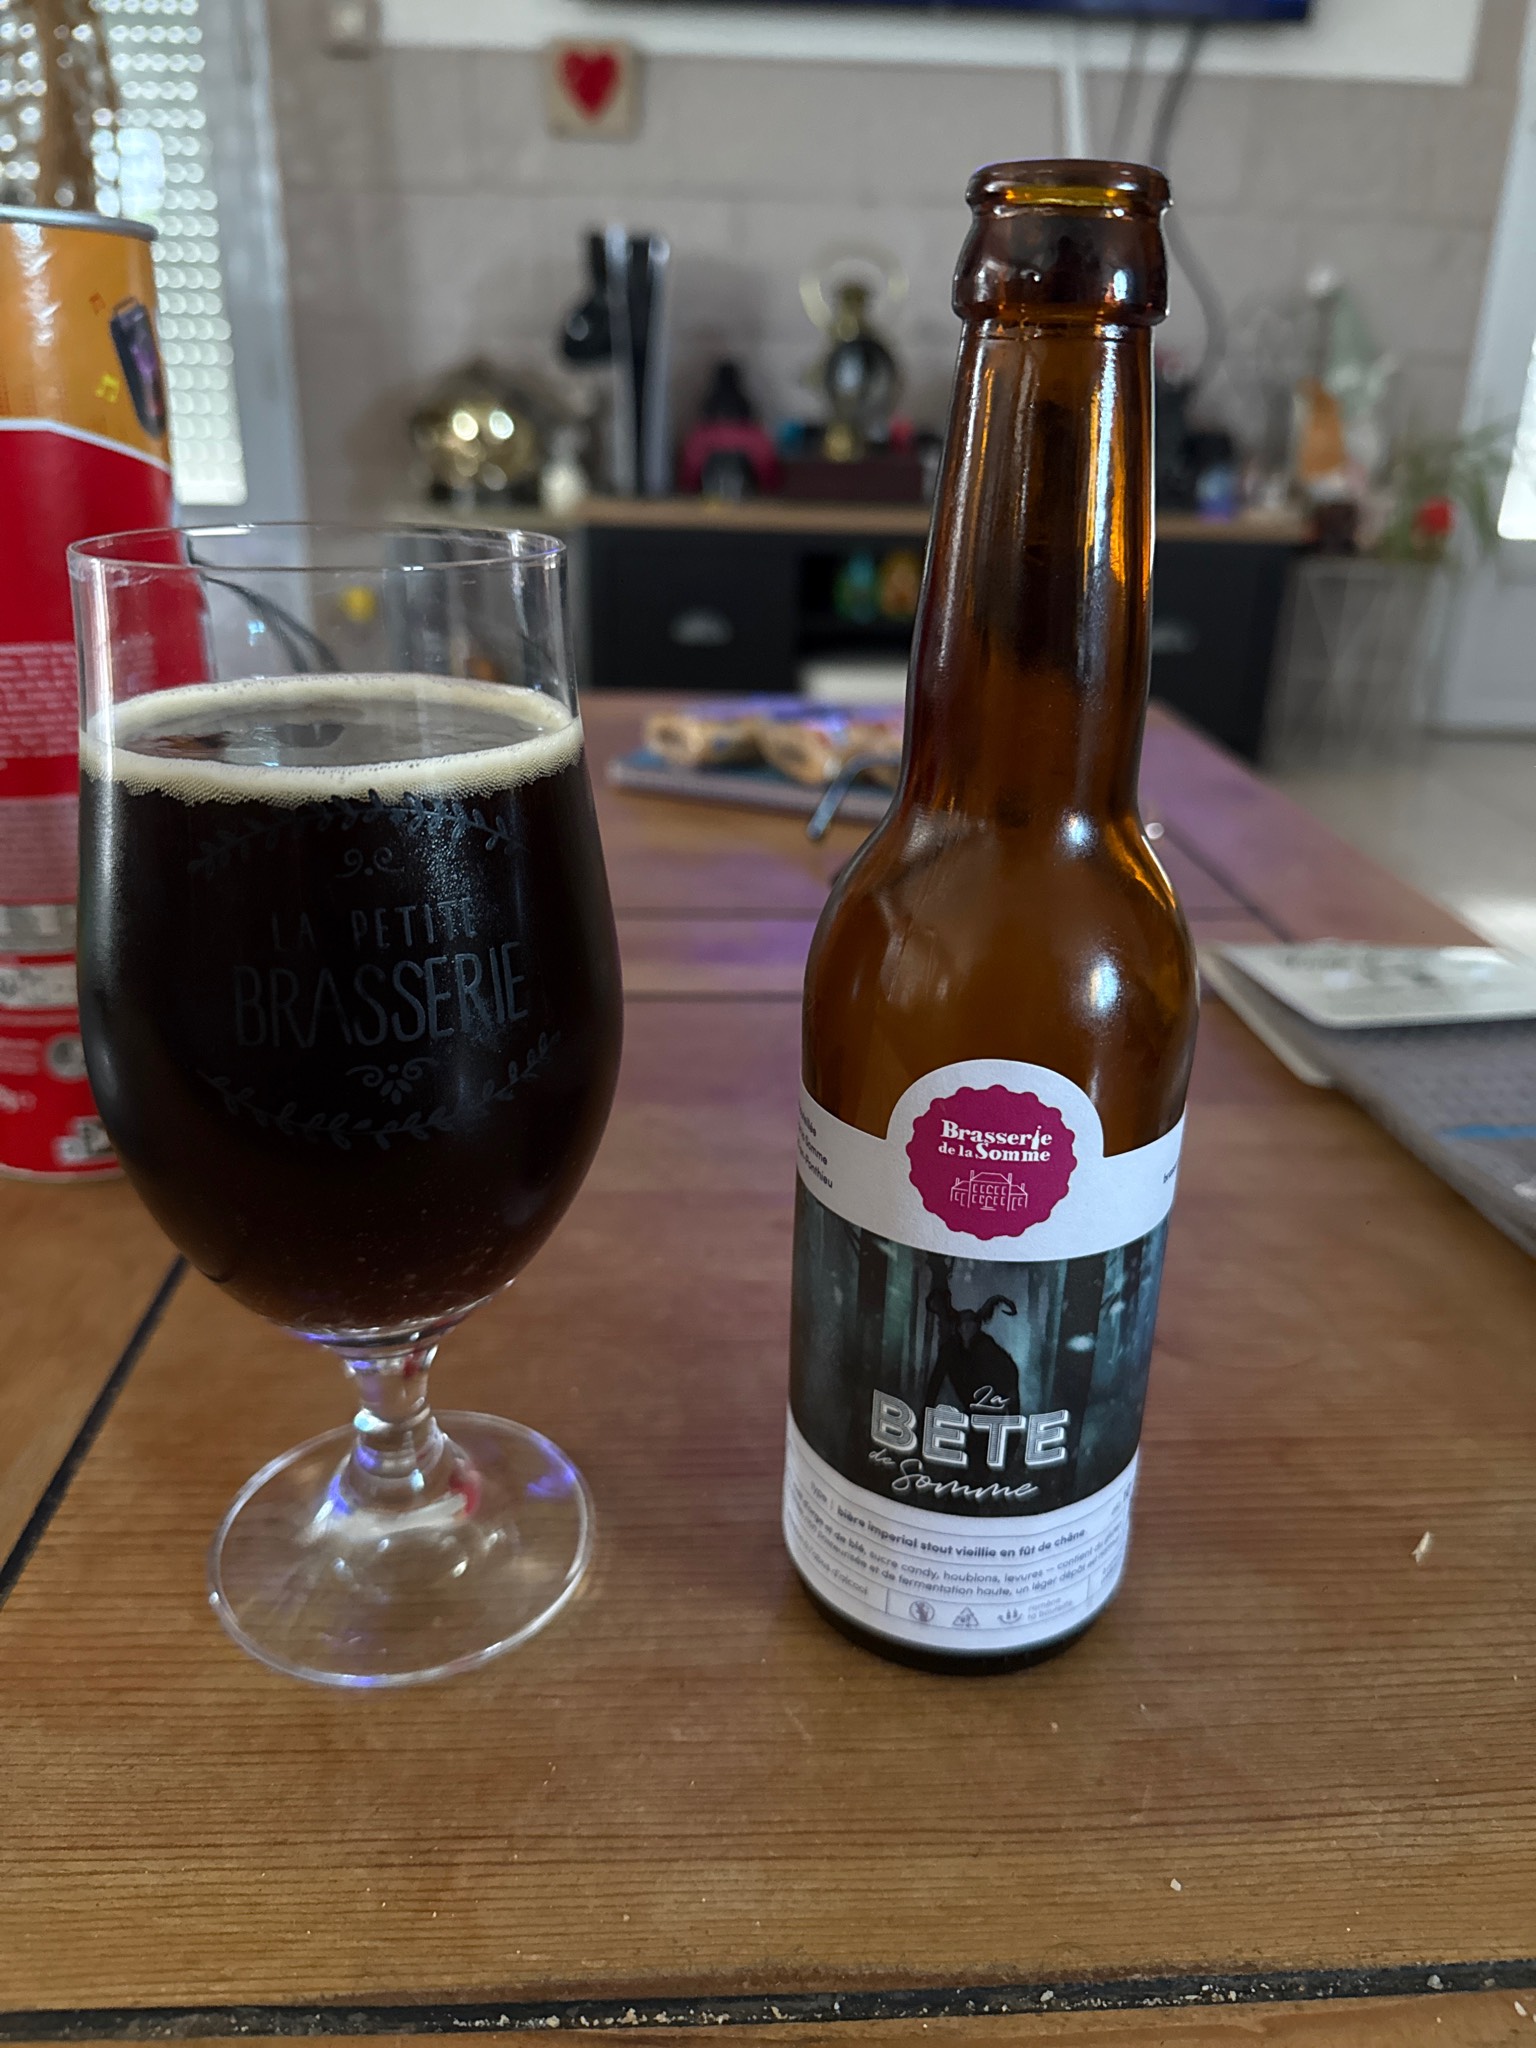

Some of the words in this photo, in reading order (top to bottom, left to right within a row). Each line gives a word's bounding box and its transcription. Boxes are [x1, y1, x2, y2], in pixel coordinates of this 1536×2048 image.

[271, 911, 318, 953] LA
[351, 897, 479, 952] PETITE
[233, 941, 530, 1049] BRASSERIE
[937, 1141, 956, 1156] de
[959, 1144, 974, 1159] la
[975, 1142, 1052, 1162] Somme
[940, 1118, 1053, 1151] Brasserie
[969, 1384, 1011, 1411] La
[891, 1457, 1040, 1501] Somme
[836, 1504, 866, 1528] bière
[867, 1519, 918, 1550] imperial
[919, 1541, 954, 1556] stout
[955, 1545, 997, 1558] vieillie
[999, 1547, 1016, 1558] en
[1018, 1545, 1036, 1557] fût
[1037, 1539, 1053, 1553] de
[1054, 1527, 1086, 1548] chêne
[869, 1550, 899, 1569] sucre
[901, 1561, 940, 1581] candy,
[942, 1570, 1001, 1584] houblons,
[1003, 1568, 1044, 1584] levures
[898, 1573, 974, 1596] fermentation
[976, 1585, 1014, 1597] haute,
